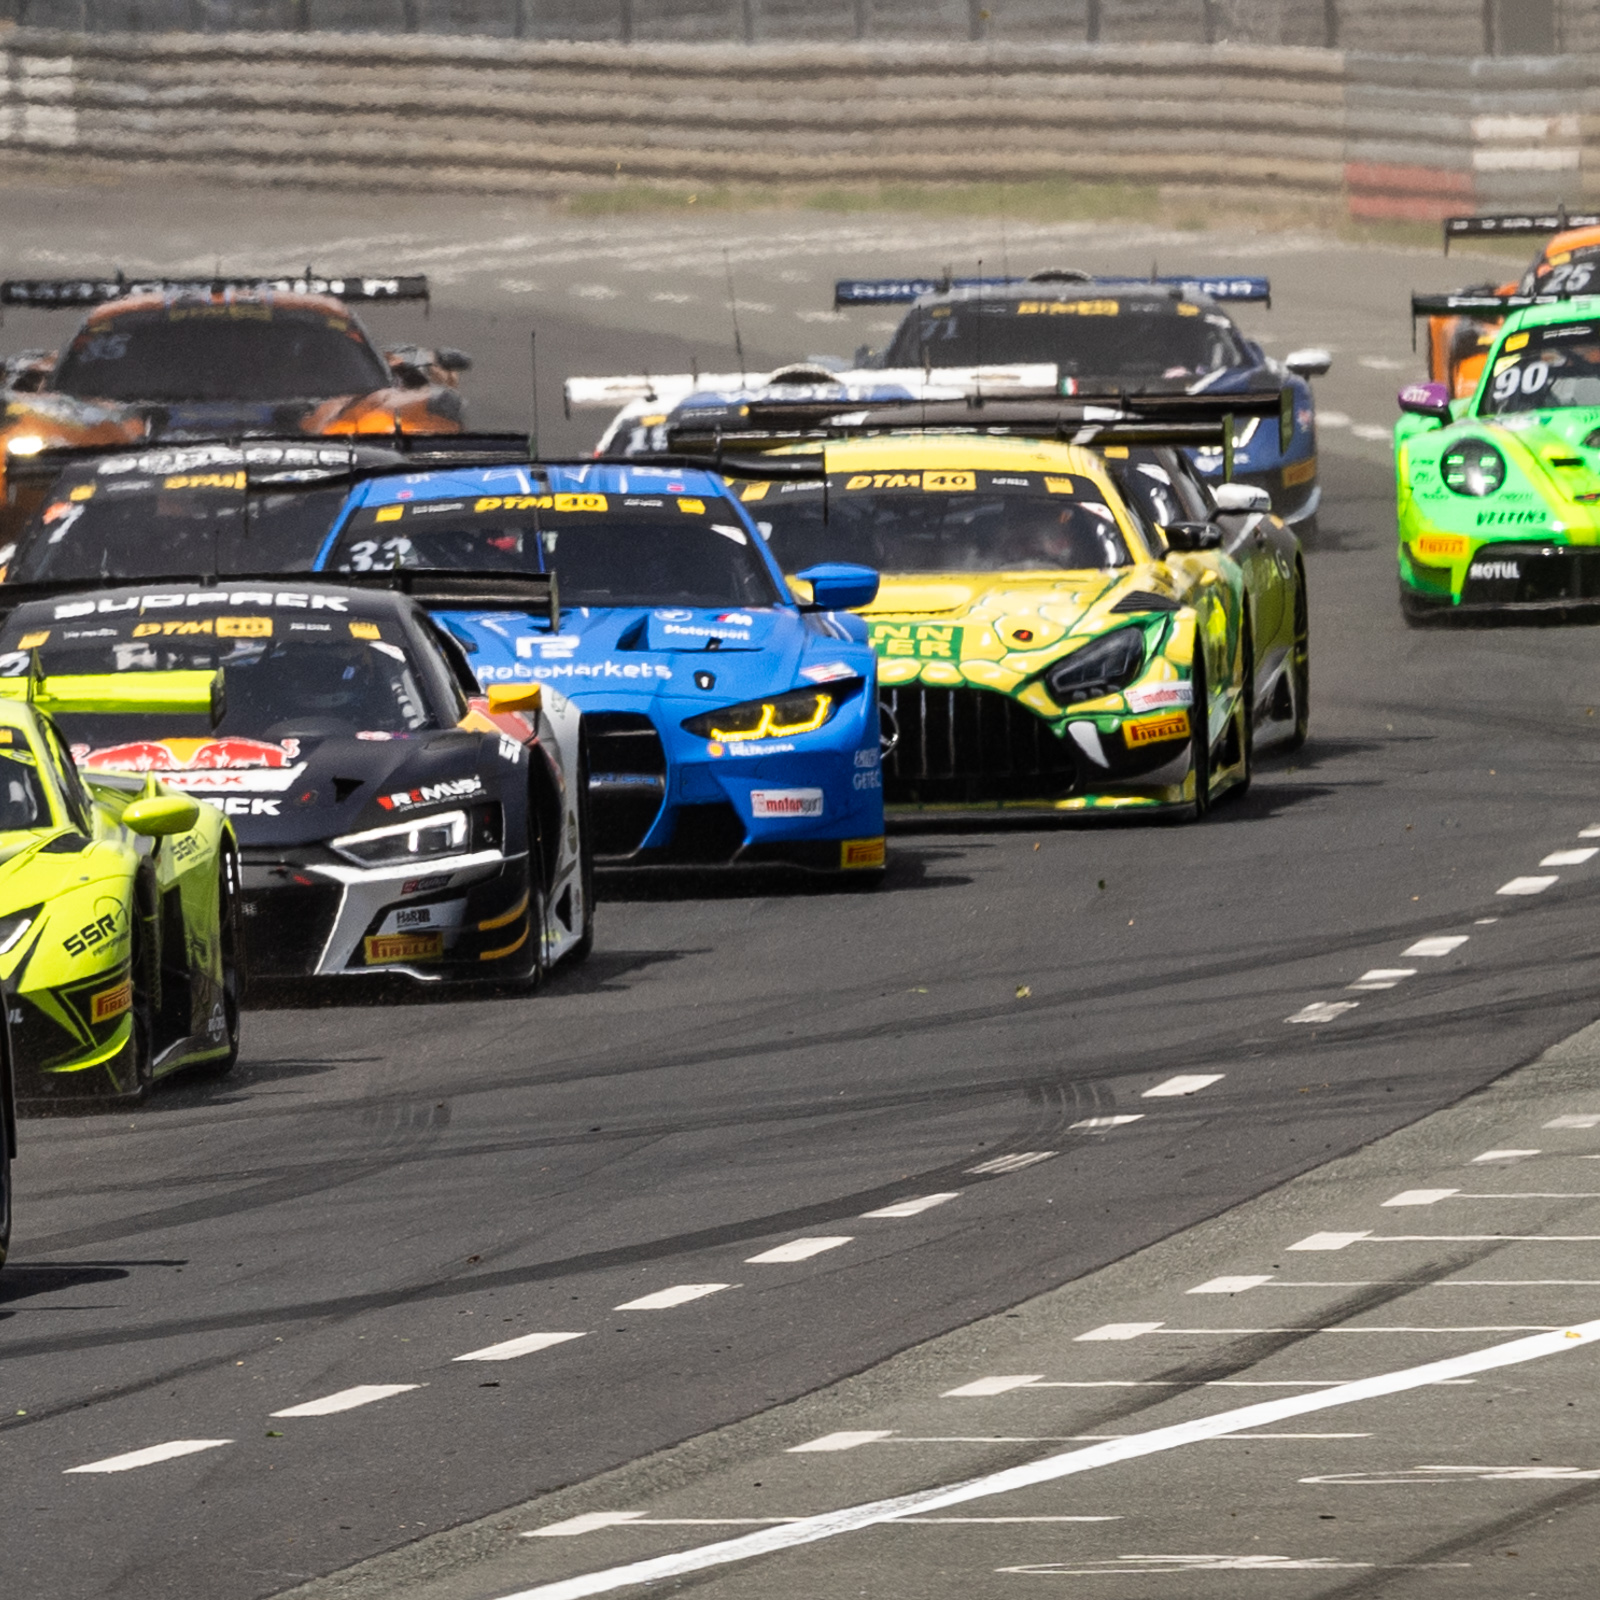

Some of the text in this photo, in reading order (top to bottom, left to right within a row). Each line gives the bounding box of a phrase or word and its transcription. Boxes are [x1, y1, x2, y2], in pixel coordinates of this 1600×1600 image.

[1541, 263, 1595, 292] 25
[1493, 361, 1549, 399] 90
[847, 474, 968, 490] DTM 40
[475, 496, 554, 512] DTM
[339, 536, 412, 572] 33
[1470, 561, 1521, 580] MOTUL
[132, 619, 215, 638] DTM
[873, 625, 954, 641] NN
[477, 660, 673, 680] RoboMarkets
[1132, 715, 1187, 741] PIRELLI
[62, 913, 118, 959] SSR
